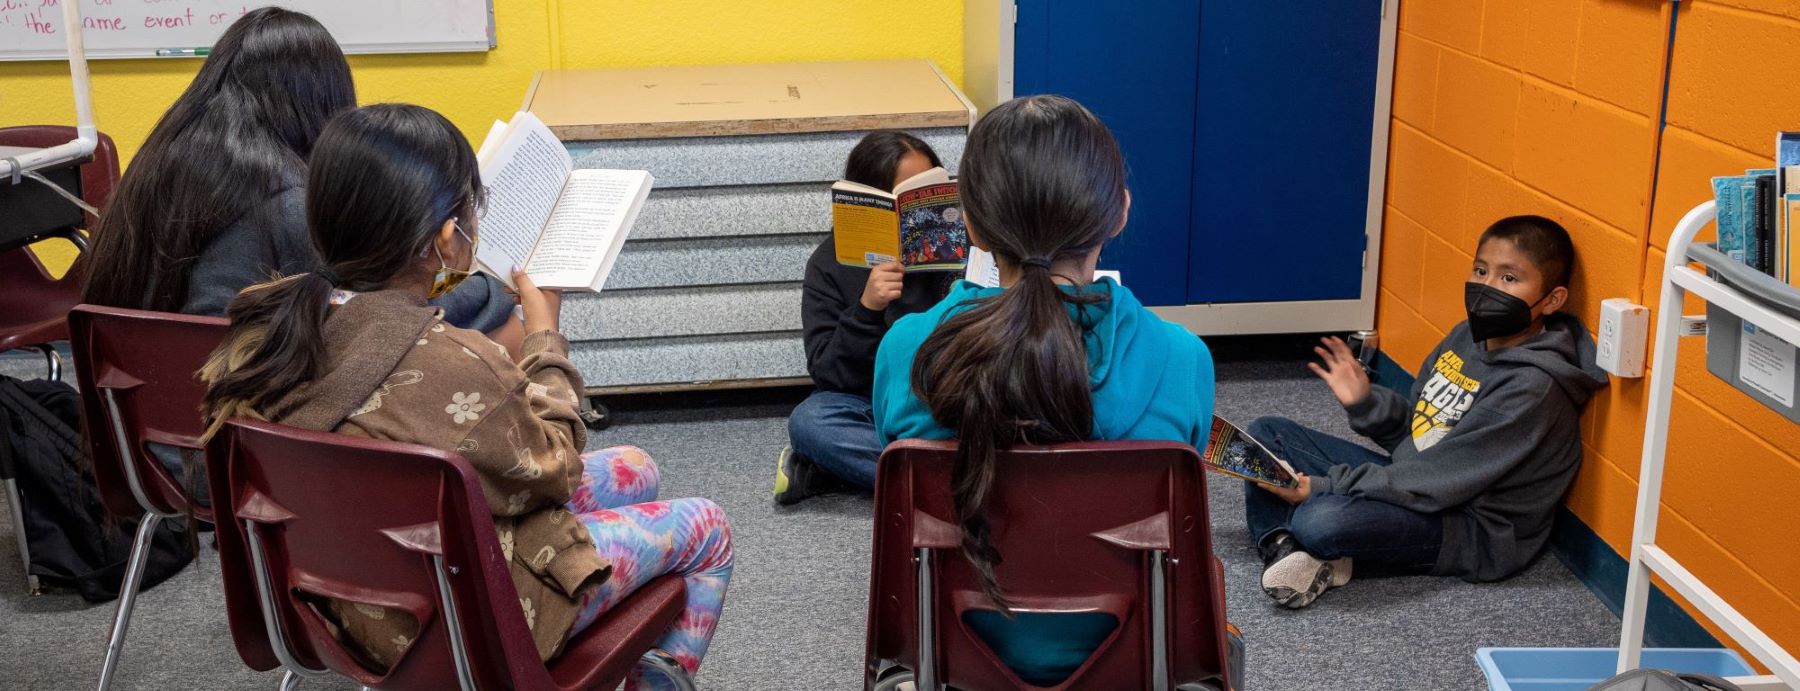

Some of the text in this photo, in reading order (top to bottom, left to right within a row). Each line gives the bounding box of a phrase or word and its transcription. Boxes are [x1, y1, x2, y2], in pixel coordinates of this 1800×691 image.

[24, 12, 56, 34] the
[81, 16, 127, 31] ame
[144, 7, 195, 29] event
[209, 12, 229, 25] or
